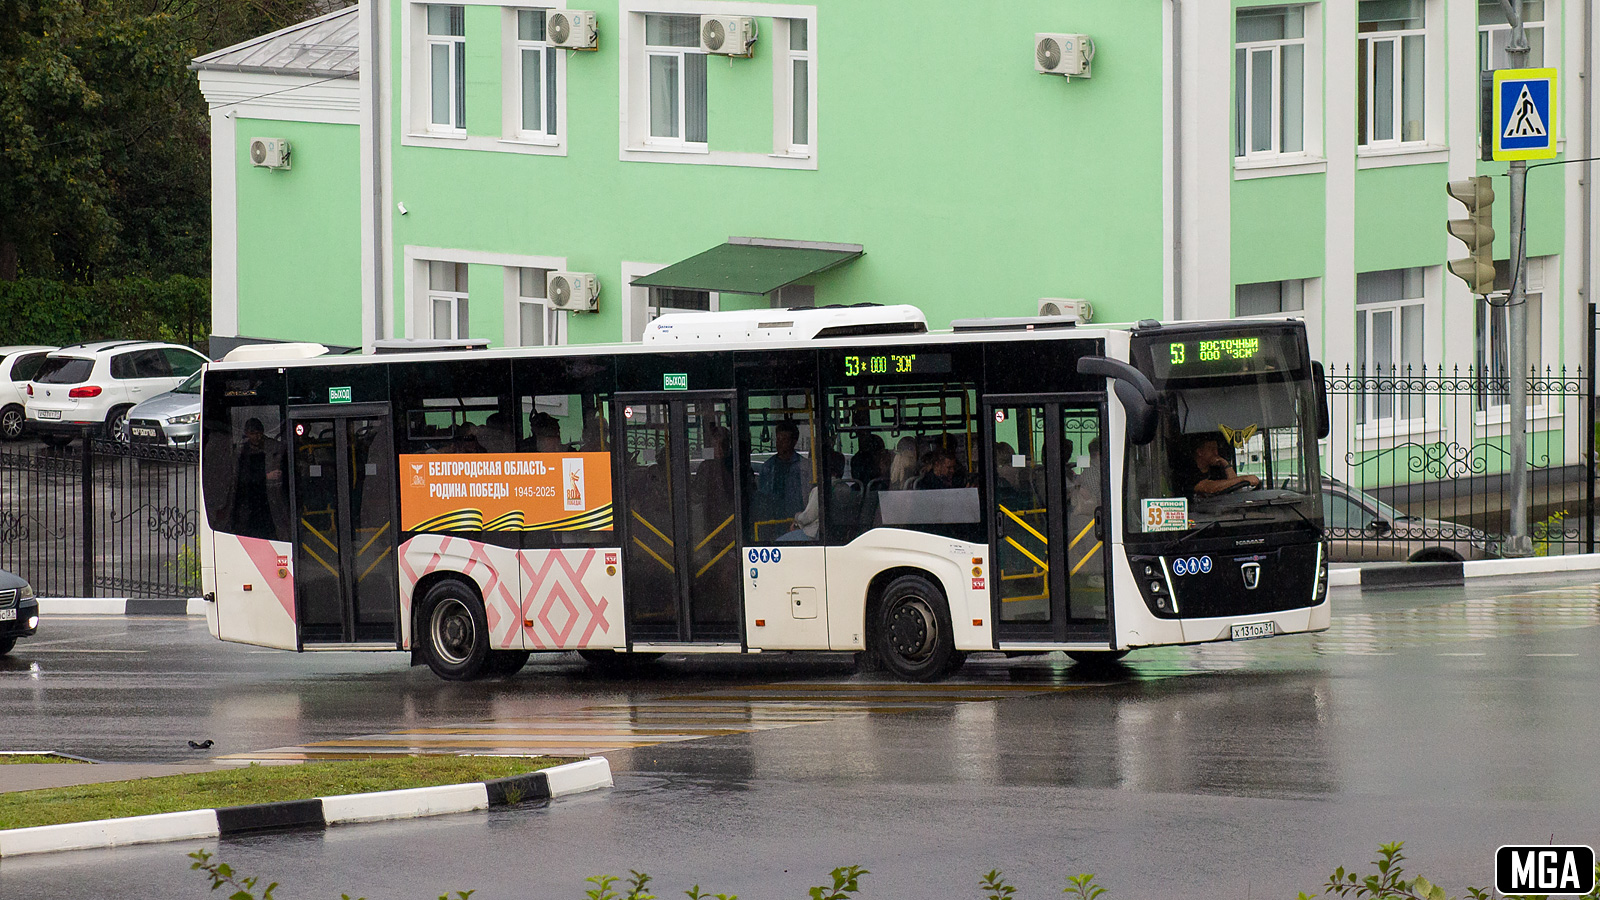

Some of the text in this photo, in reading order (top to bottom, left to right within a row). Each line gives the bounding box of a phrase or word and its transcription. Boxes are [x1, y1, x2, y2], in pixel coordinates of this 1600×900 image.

[1199, 338, 1259, 351] ВОСТОЧНЫЙ
[1170, 343, 1185, 365] 53
[845, 356, 859, 376] 53
[665, 376, 686, 388] ВЫХОД
[330, 389, 350, 400] ВЫХОД
[428, 461, 502, 478] БЕЛГОРОДСКАЯ
[504, 460, 547, 475] ОБЛАСТЬ
[429, 482, 556, 500] РОДИНА ПОБЕДЫ 1945-2025
[1148, 508, 1162, 525] 53
